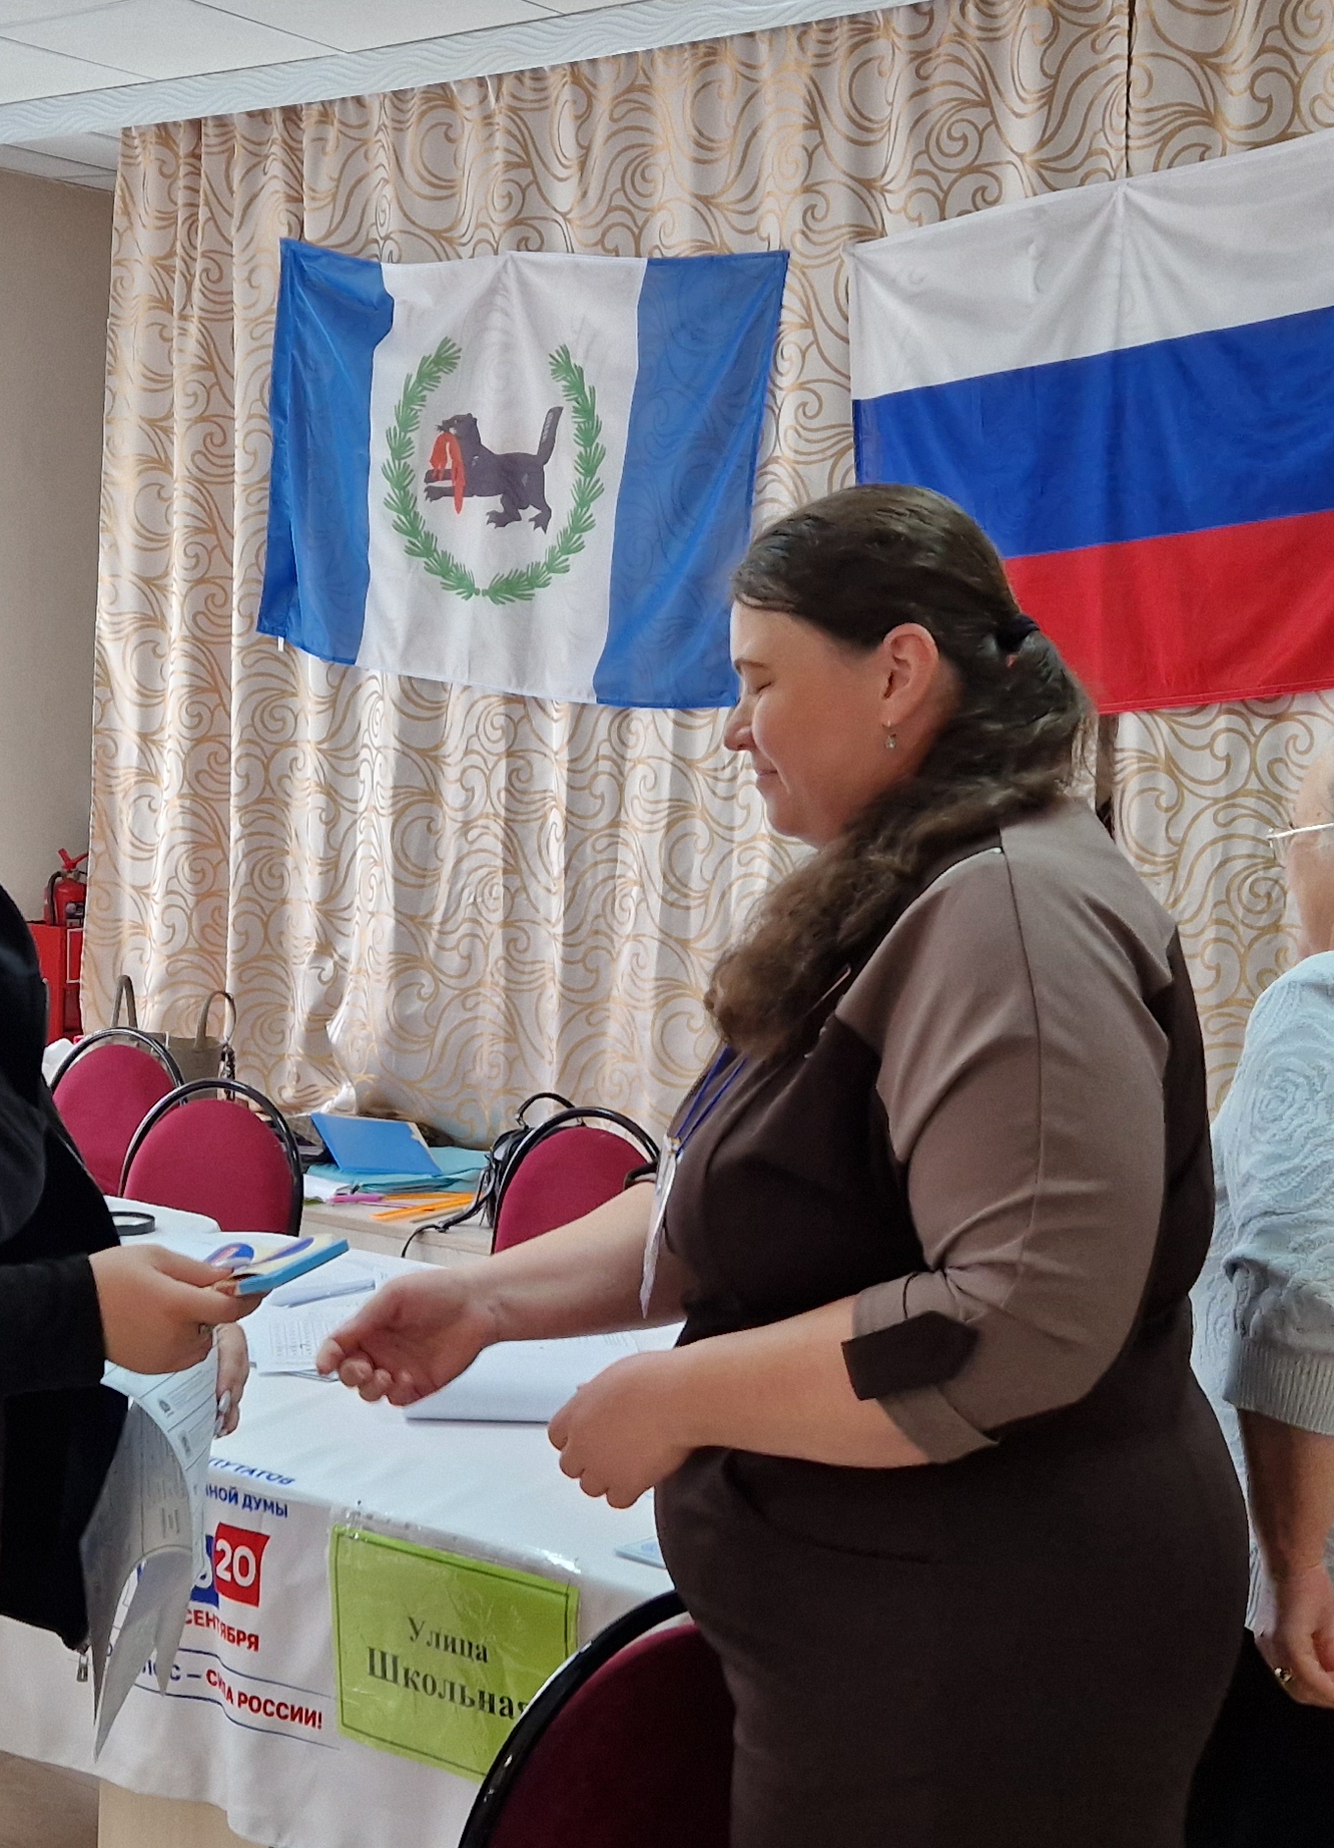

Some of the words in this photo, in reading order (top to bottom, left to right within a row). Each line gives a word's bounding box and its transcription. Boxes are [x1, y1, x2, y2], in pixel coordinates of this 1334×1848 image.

[208, 1457, 296, 1485] ПУТАТОВ
[242, 1493, 288, 1518] ДУМЫ
[215, 1538, 257, 1588] 20
[408, 1616, 488, 1663] Улица
[238, 1690, 323, 1730] РОССИИ!
